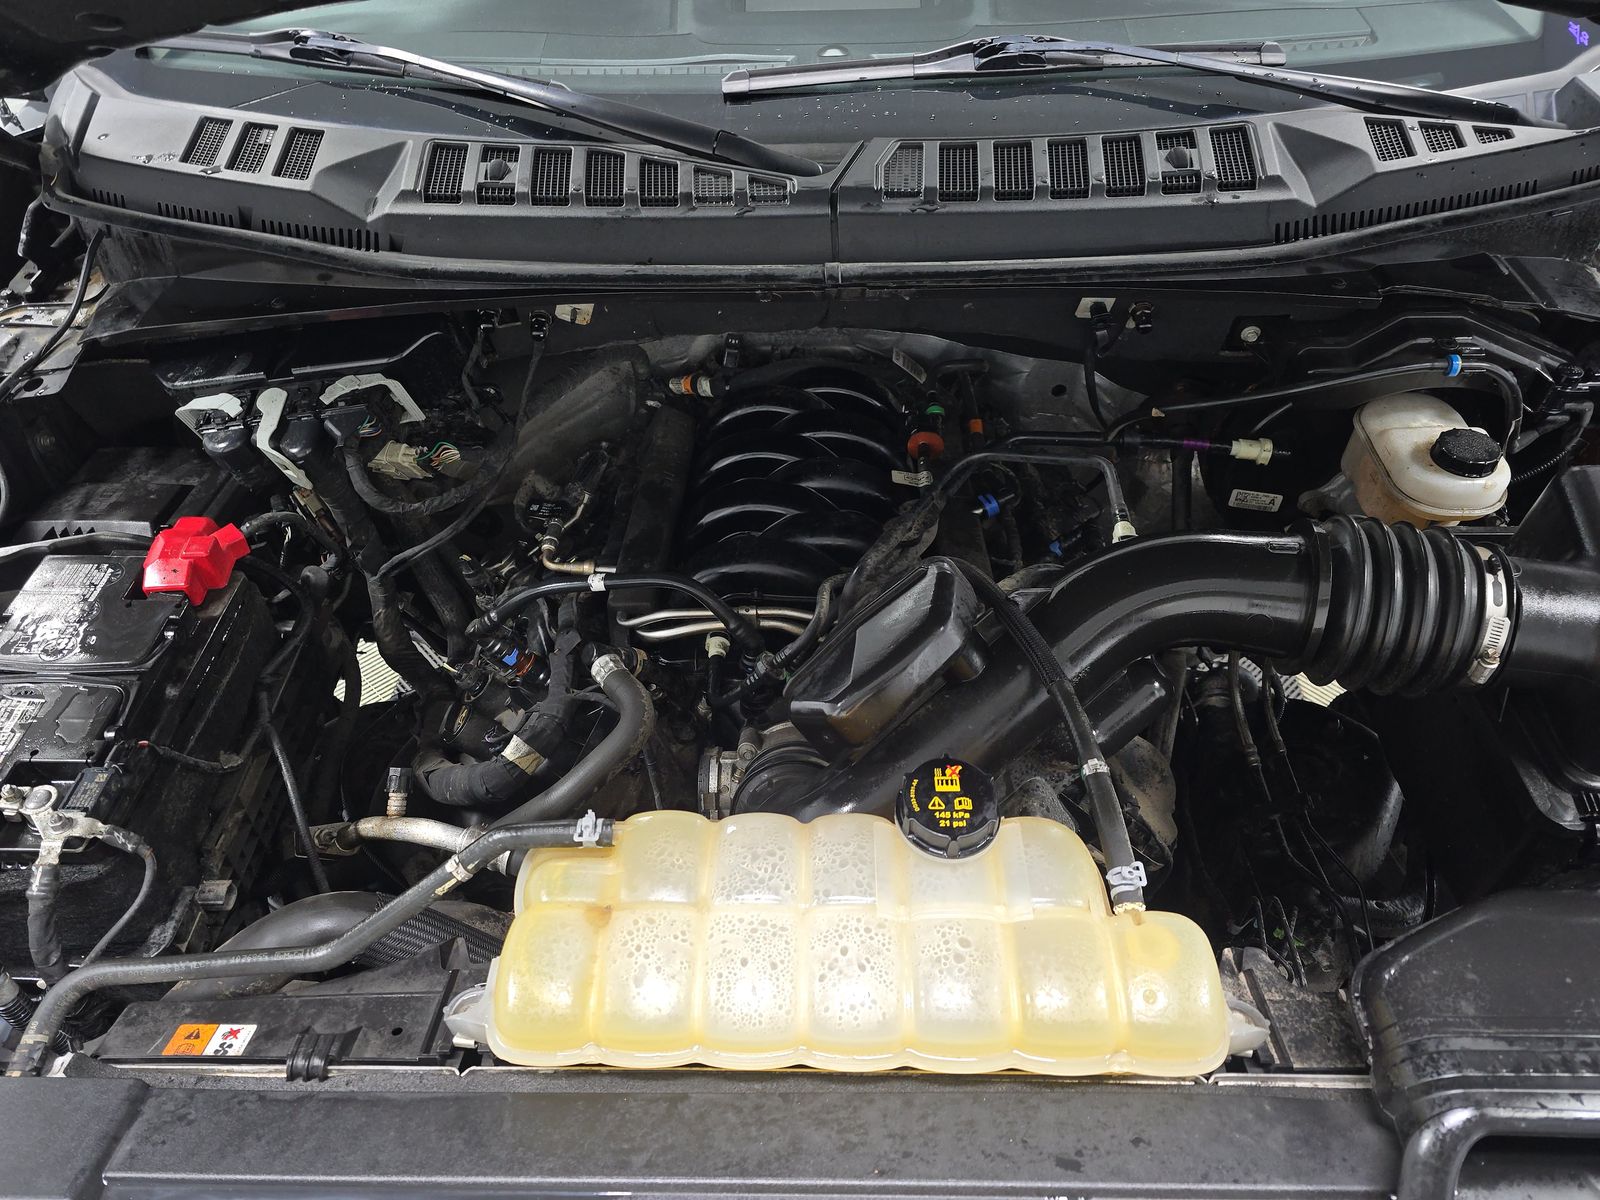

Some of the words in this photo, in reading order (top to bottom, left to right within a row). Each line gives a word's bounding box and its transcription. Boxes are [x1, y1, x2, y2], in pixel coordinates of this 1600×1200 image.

[934, 811, 951, 819] 145
[953, 811, 970, 819] kPa
[952, 820, 967, 828] psi
